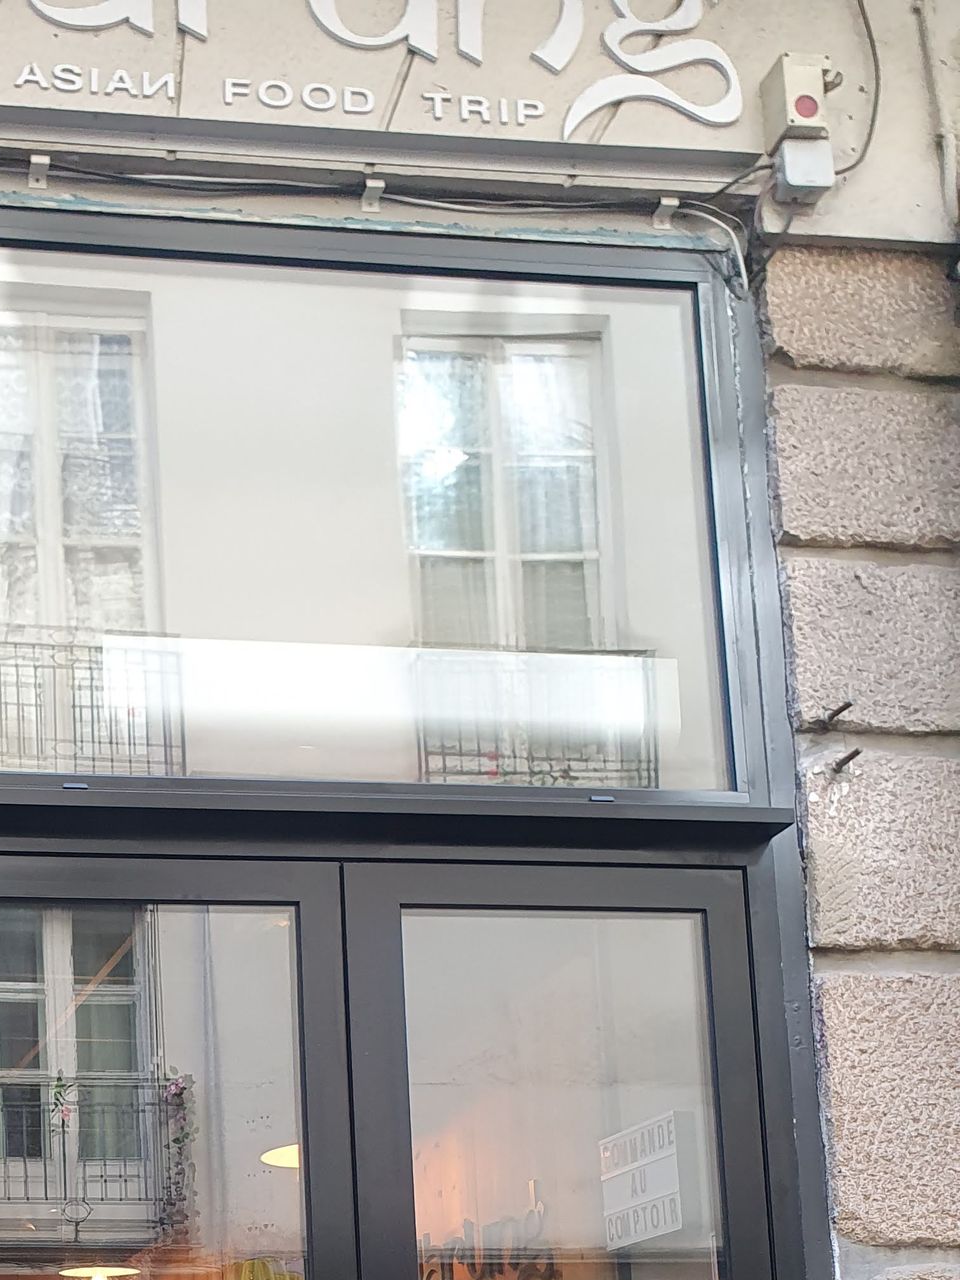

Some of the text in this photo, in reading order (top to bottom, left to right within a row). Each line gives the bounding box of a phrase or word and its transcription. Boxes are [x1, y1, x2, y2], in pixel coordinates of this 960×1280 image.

[223, 77, 376, 115] FOOD
[422, 91, 545, 127] TRIP
[631, 1168, 647, 1198] AU
[607, 1198, 679, 1243] COMPTOIR
